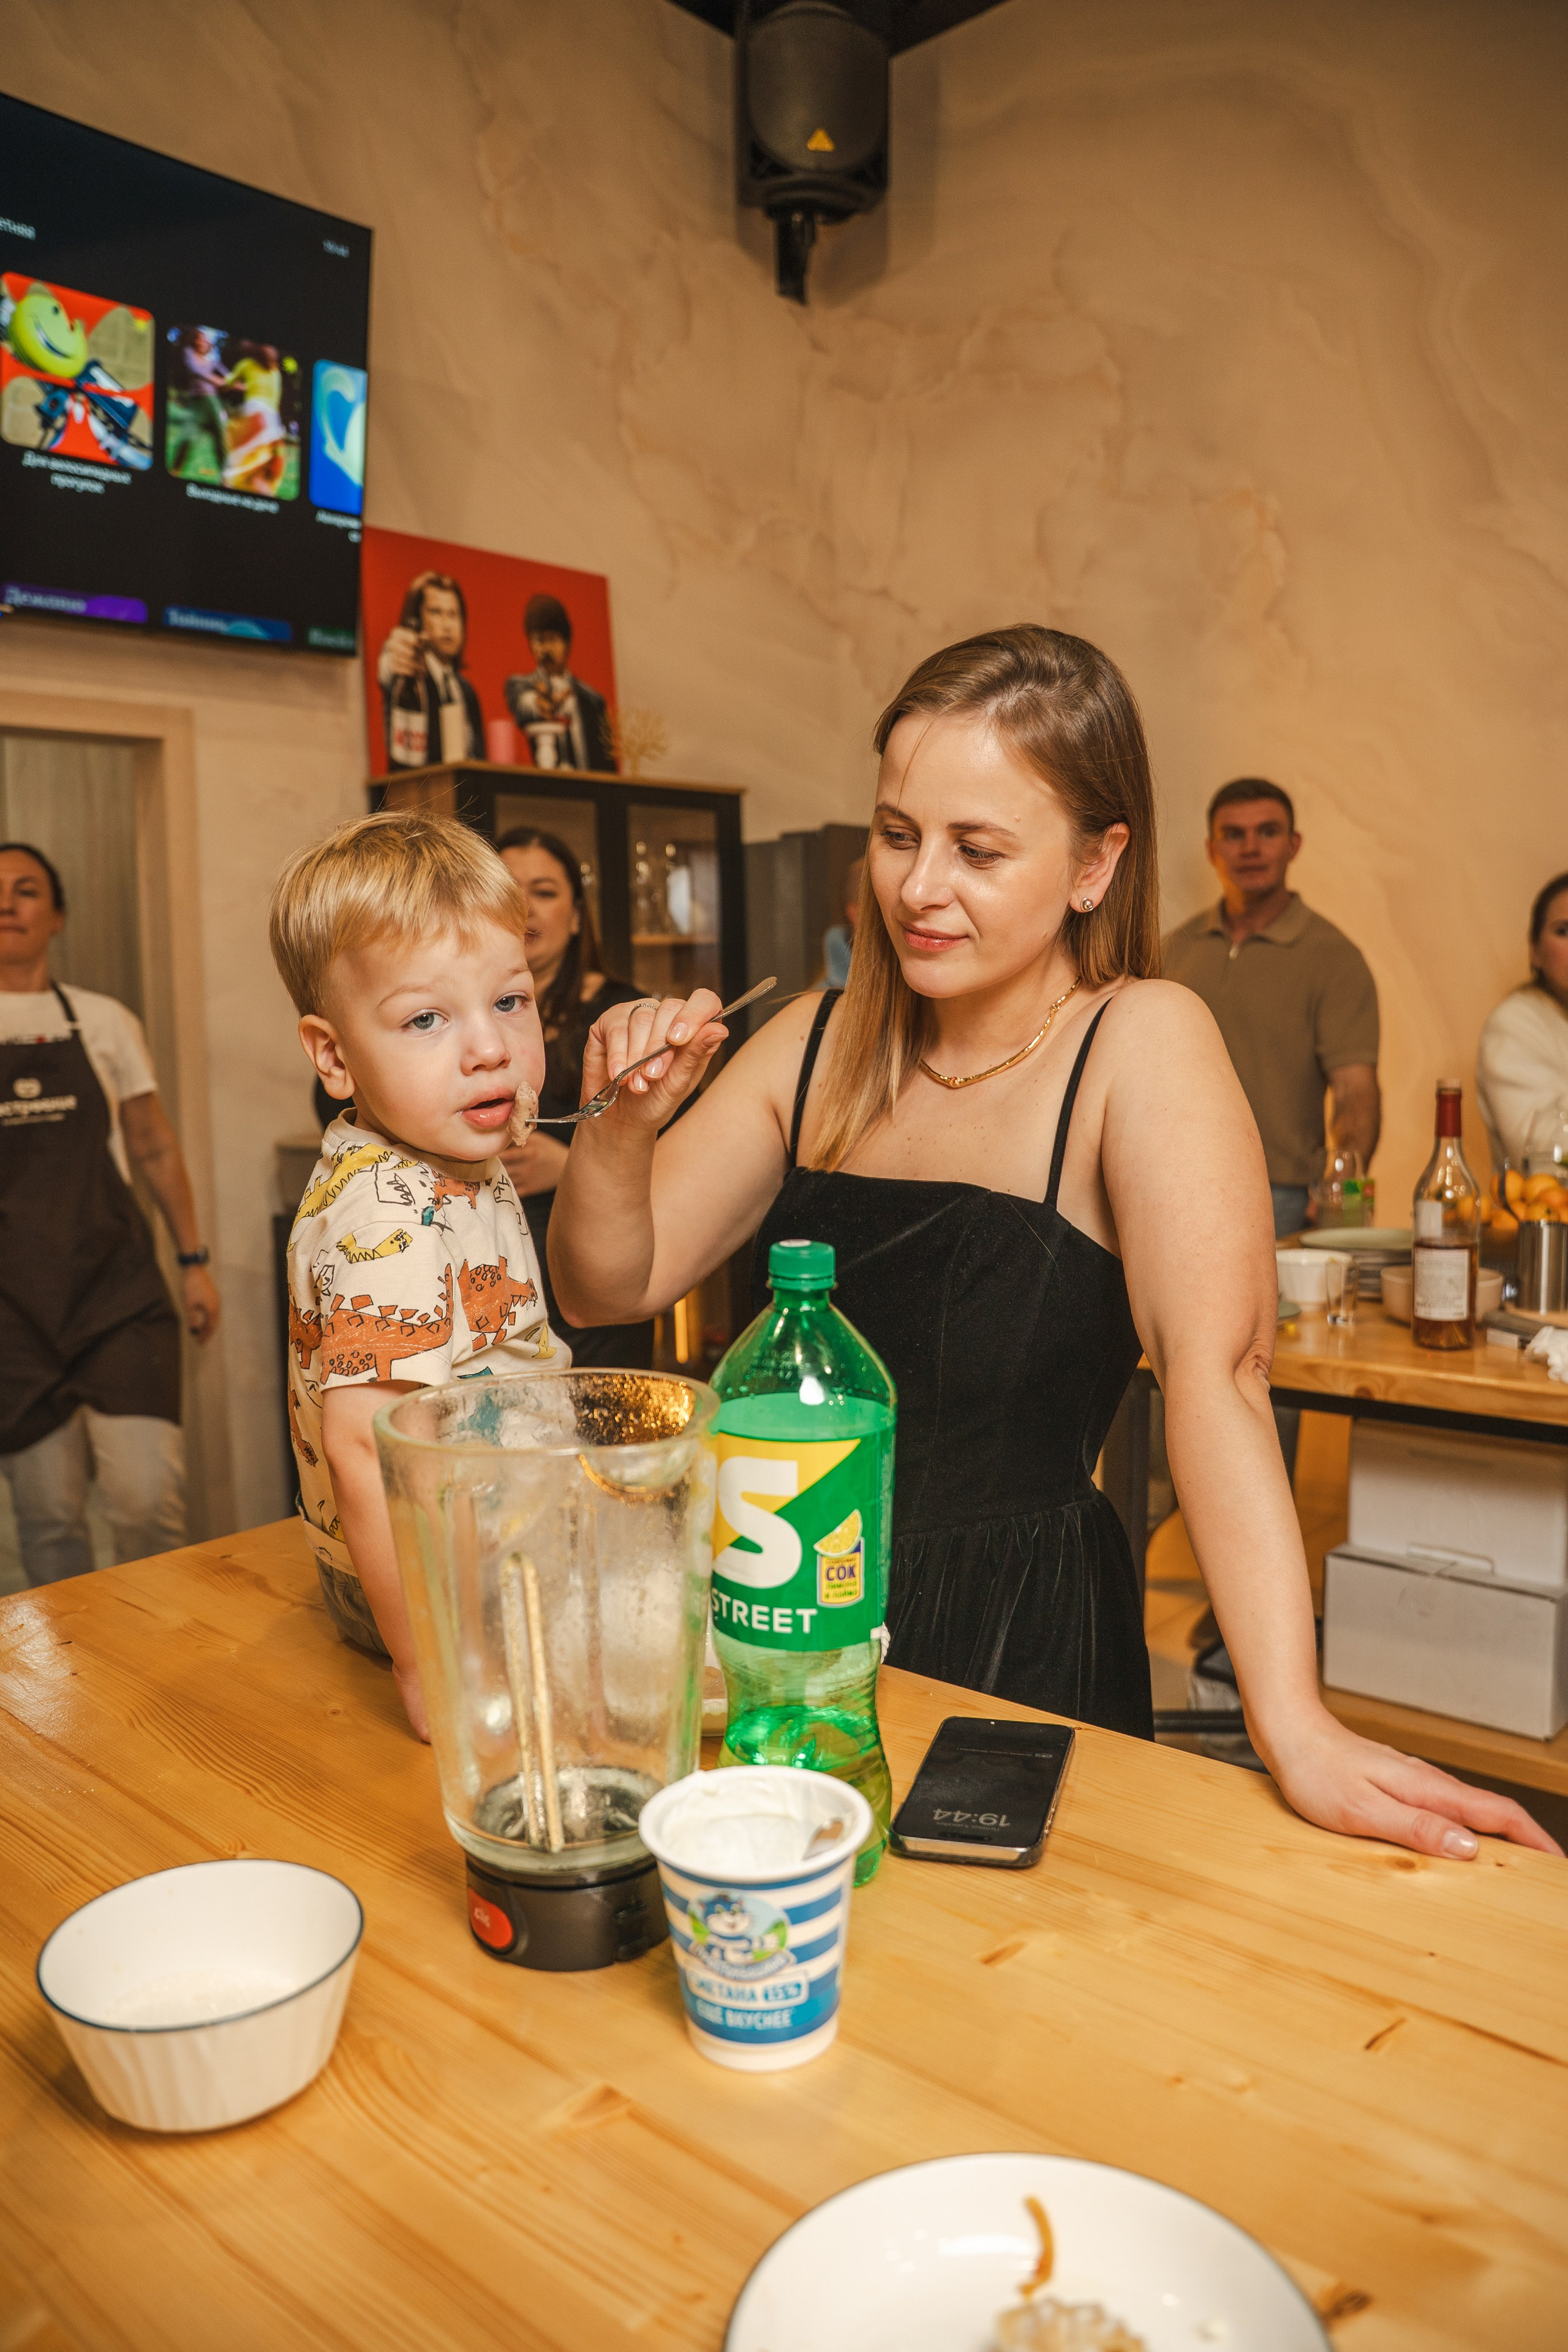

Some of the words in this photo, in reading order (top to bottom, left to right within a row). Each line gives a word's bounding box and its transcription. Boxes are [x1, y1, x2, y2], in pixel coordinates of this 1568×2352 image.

[712, 1455, 802, 1589] S
[827, 1566, 856, 1581] СОК
[711, 1587, 818, 1634] STREET
[933, 1808, 1010, 1827] 19:44
